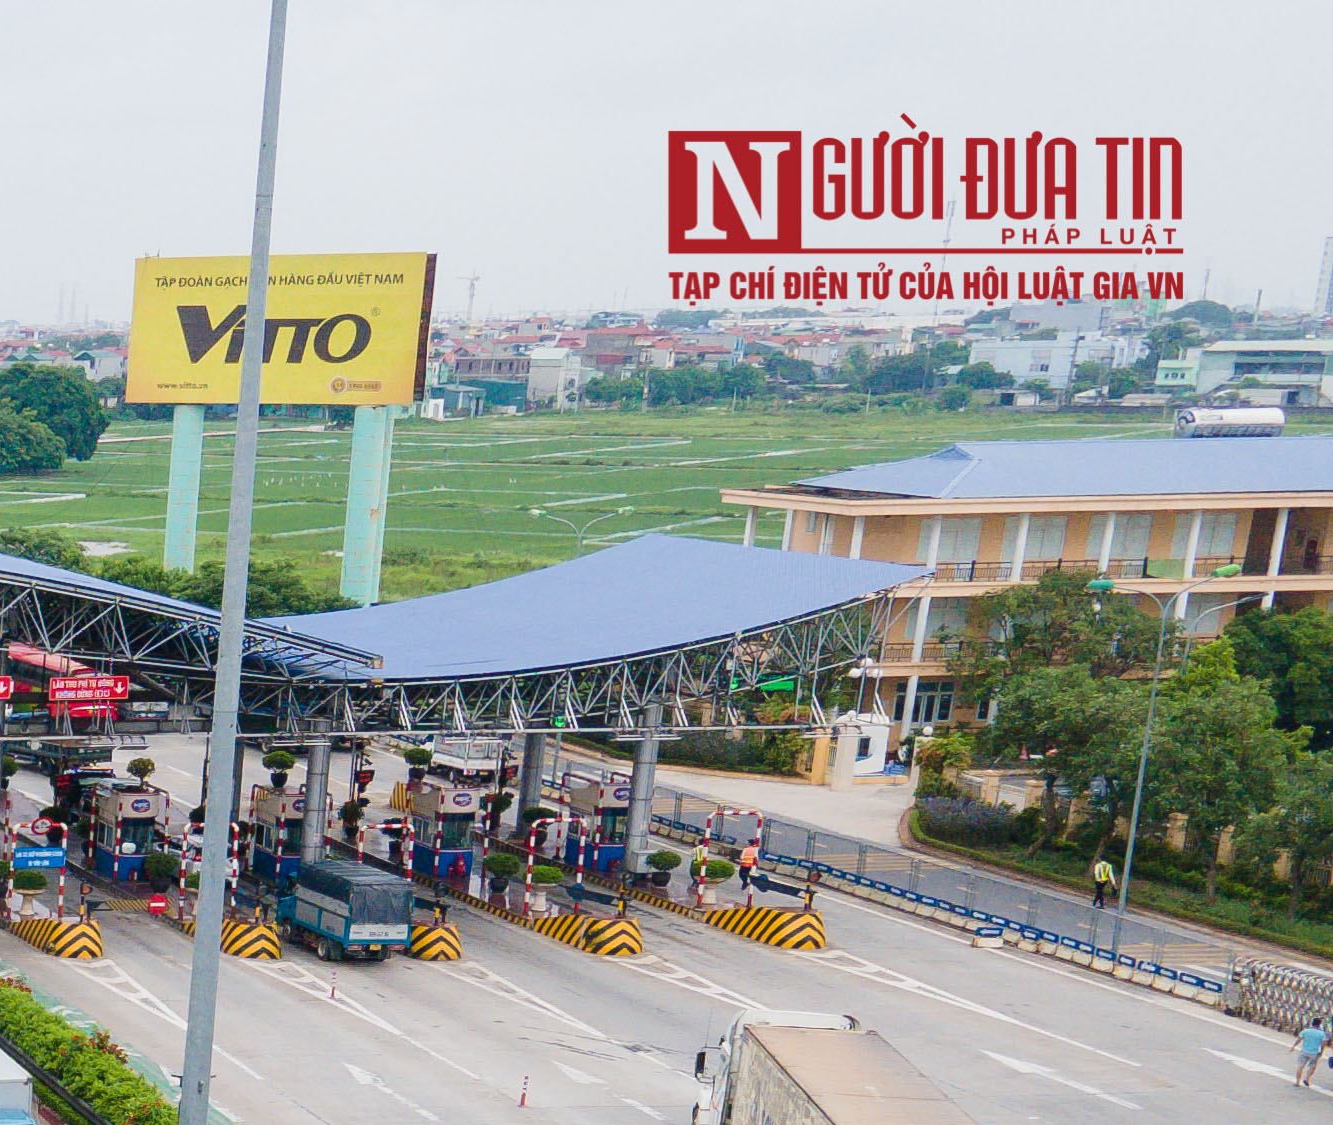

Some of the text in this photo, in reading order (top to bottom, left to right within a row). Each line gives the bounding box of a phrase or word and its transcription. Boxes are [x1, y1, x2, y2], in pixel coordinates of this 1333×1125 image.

[155, 275, 248, 291] TẬP ĐOÀN GẠCH
[279, 272, 314, 285] HÀNG
[317, 272, 343, 285] ĐẦU
[346, 272, 372, 287] VIỆT
[374, 274, 404, 284] NAM
